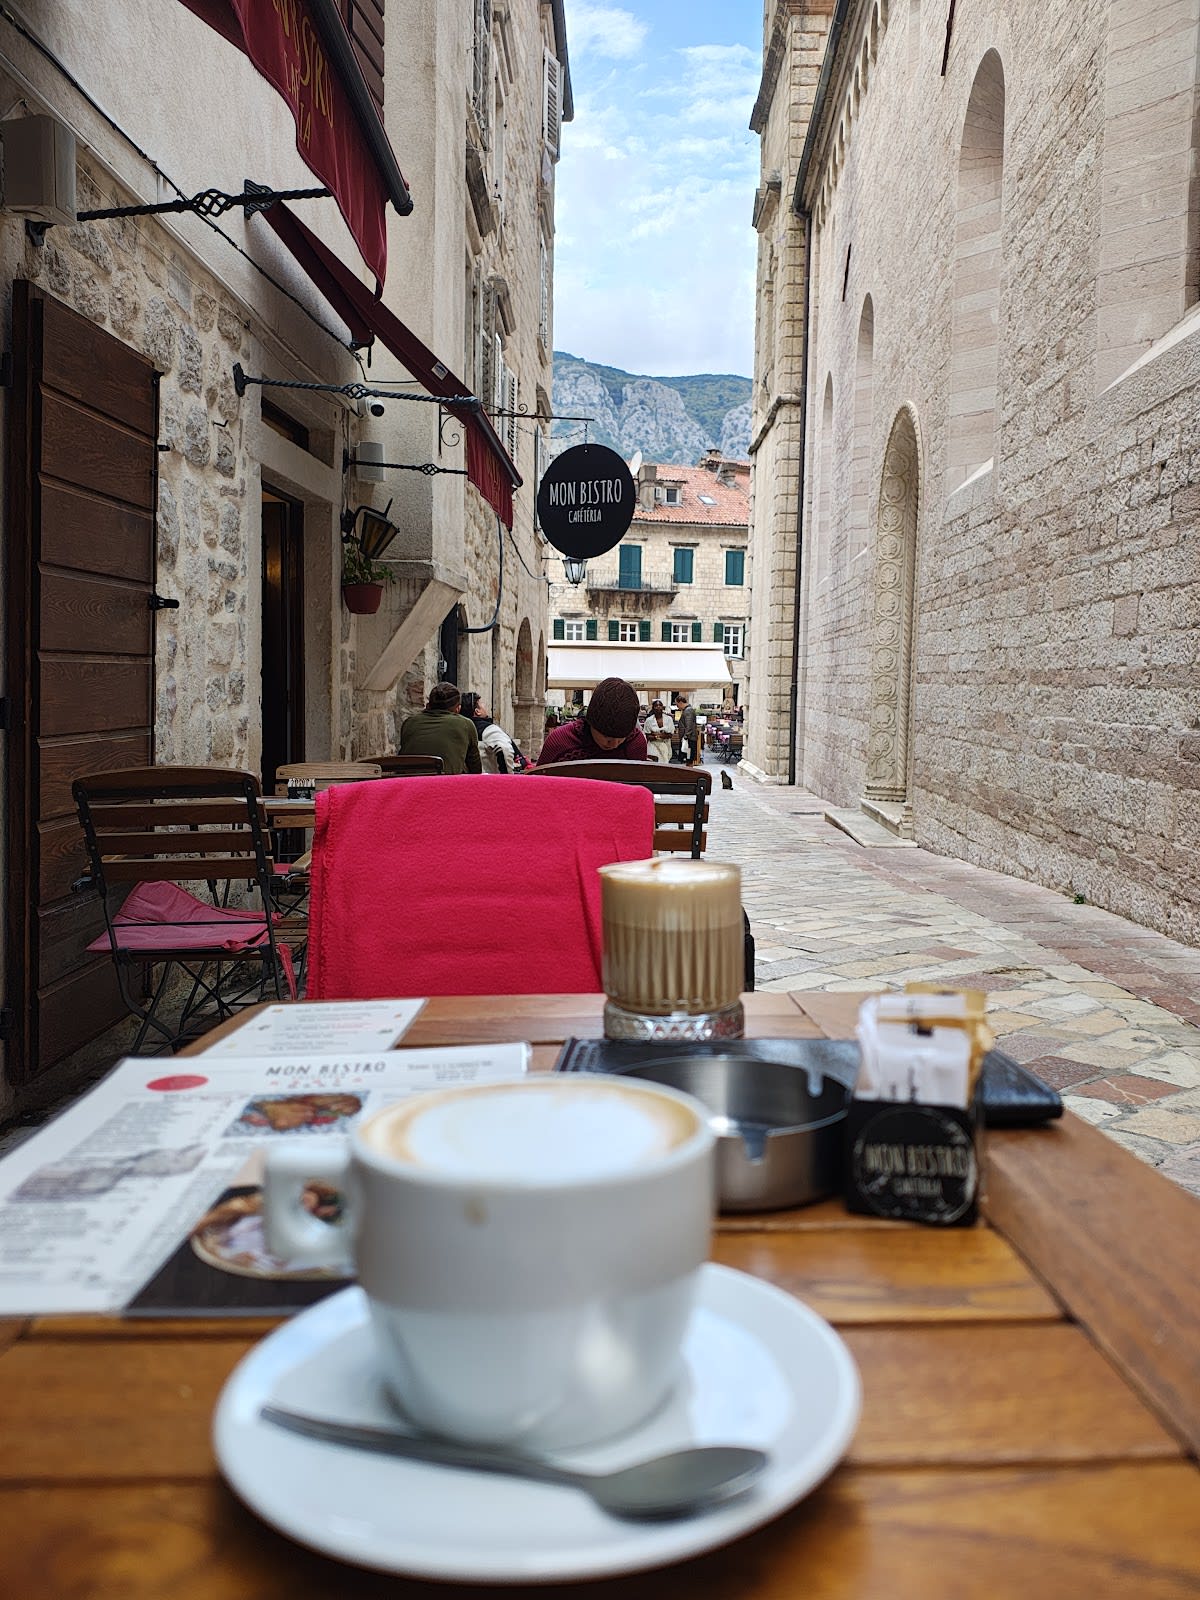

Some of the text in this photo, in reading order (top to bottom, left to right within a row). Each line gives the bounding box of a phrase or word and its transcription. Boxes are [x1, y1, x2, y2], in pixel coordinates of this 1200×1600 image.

[550, 478, 622, 506] MON BISTRO
[266, 1061, 386, 1076] MON BISTRO
[866, 1144, 967, 1177] MON BISTRO
